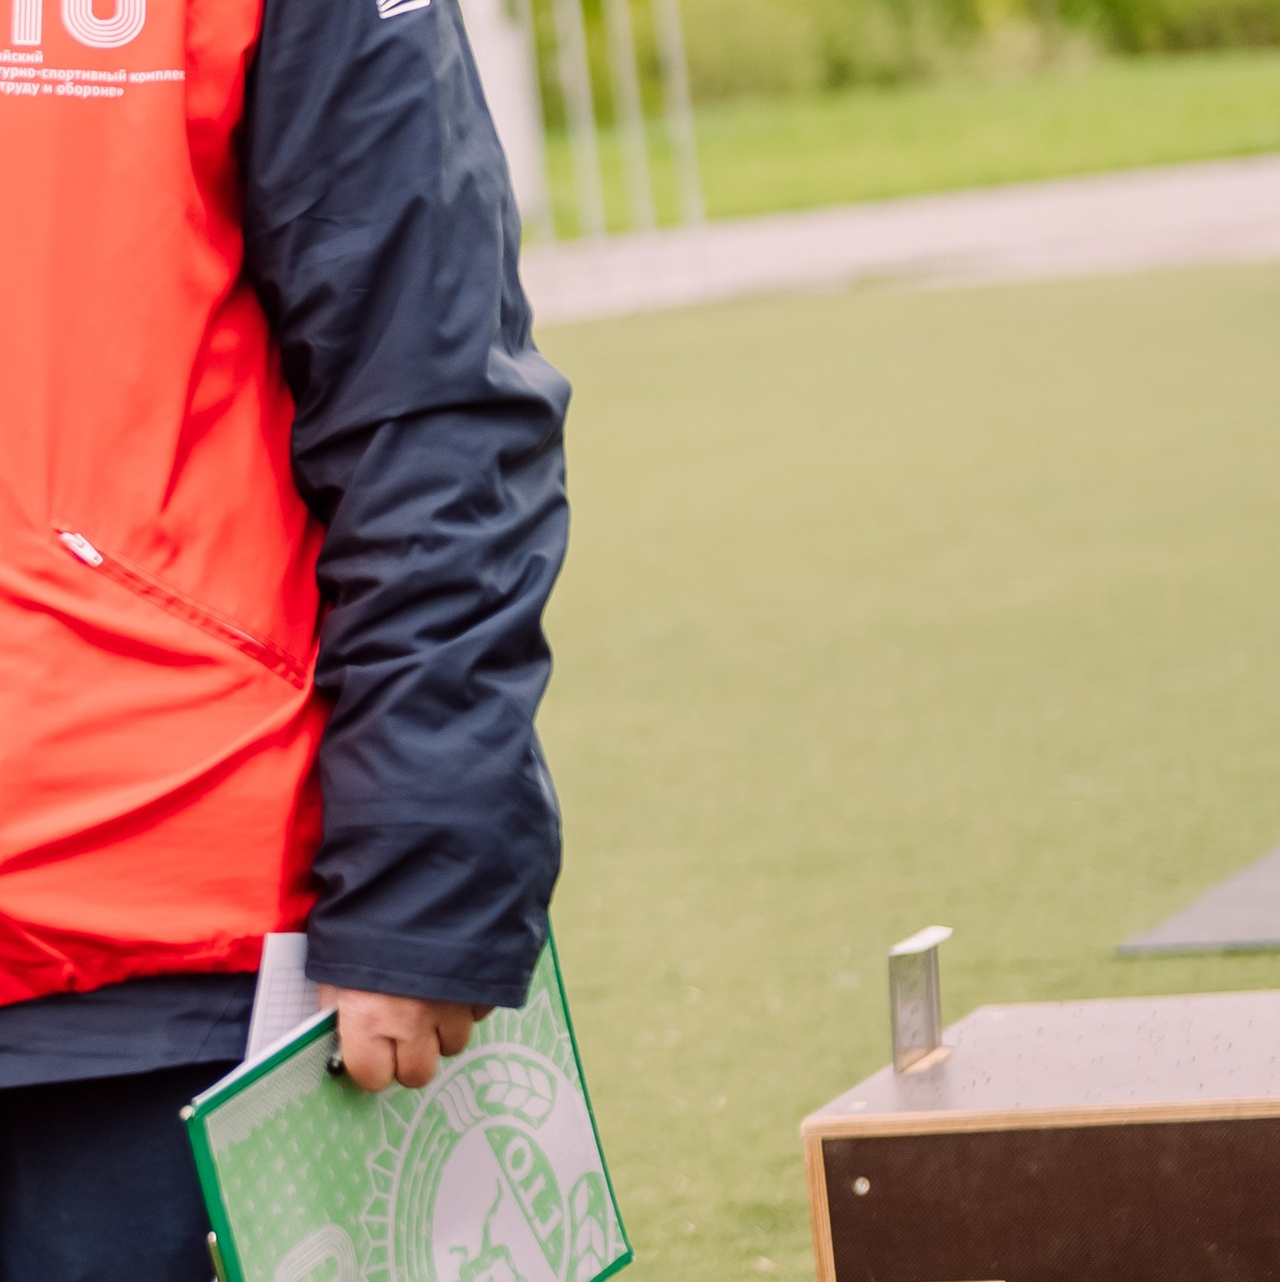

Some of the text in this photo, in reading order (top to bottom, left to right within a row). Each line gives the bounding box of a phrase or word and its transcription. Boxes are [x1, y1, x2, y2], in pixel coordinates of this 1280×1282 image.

[42, 83, 53, 94] и
[56, 80, 125, 99] обороне»
[505, 1135, 563, 1243] ГТО
